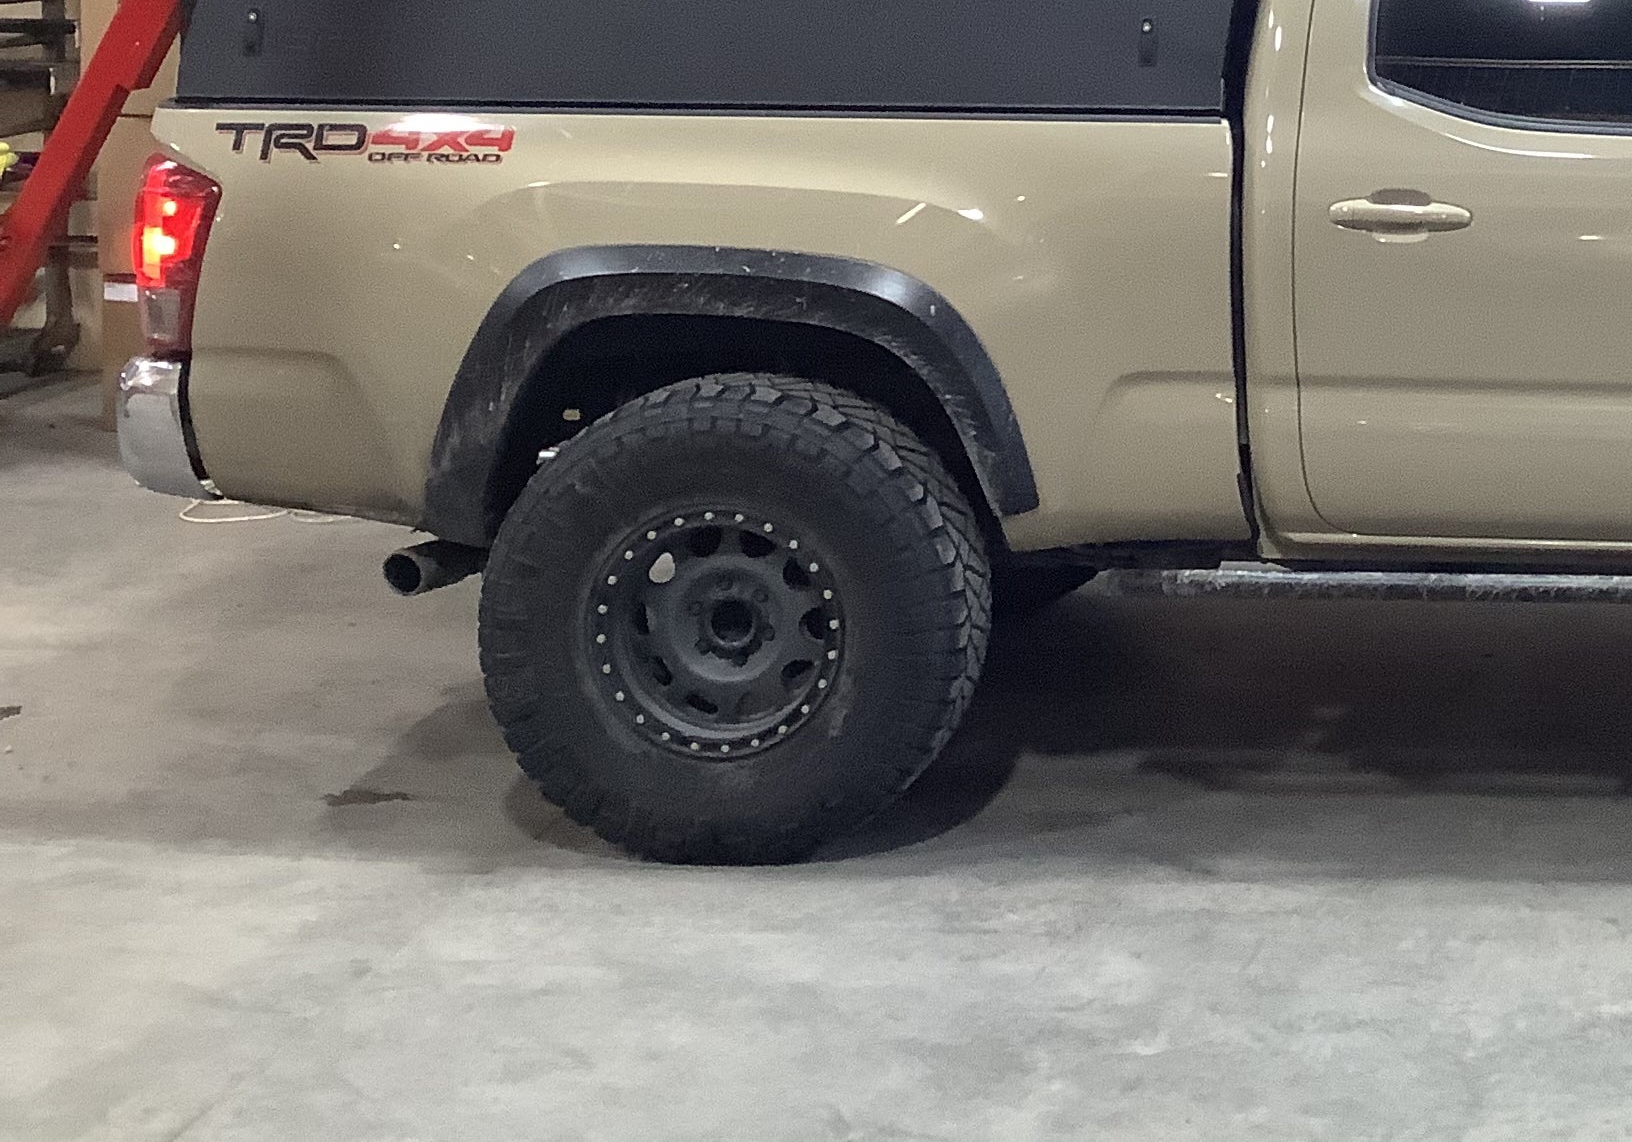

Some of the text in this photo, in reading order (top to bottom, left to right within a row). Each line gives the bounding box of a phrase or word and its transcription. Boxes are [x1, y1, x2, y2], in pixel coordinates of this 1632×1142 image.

[215, 122, 368, 162] TRD
[367, 152, 503, 164] OFF ROAD
